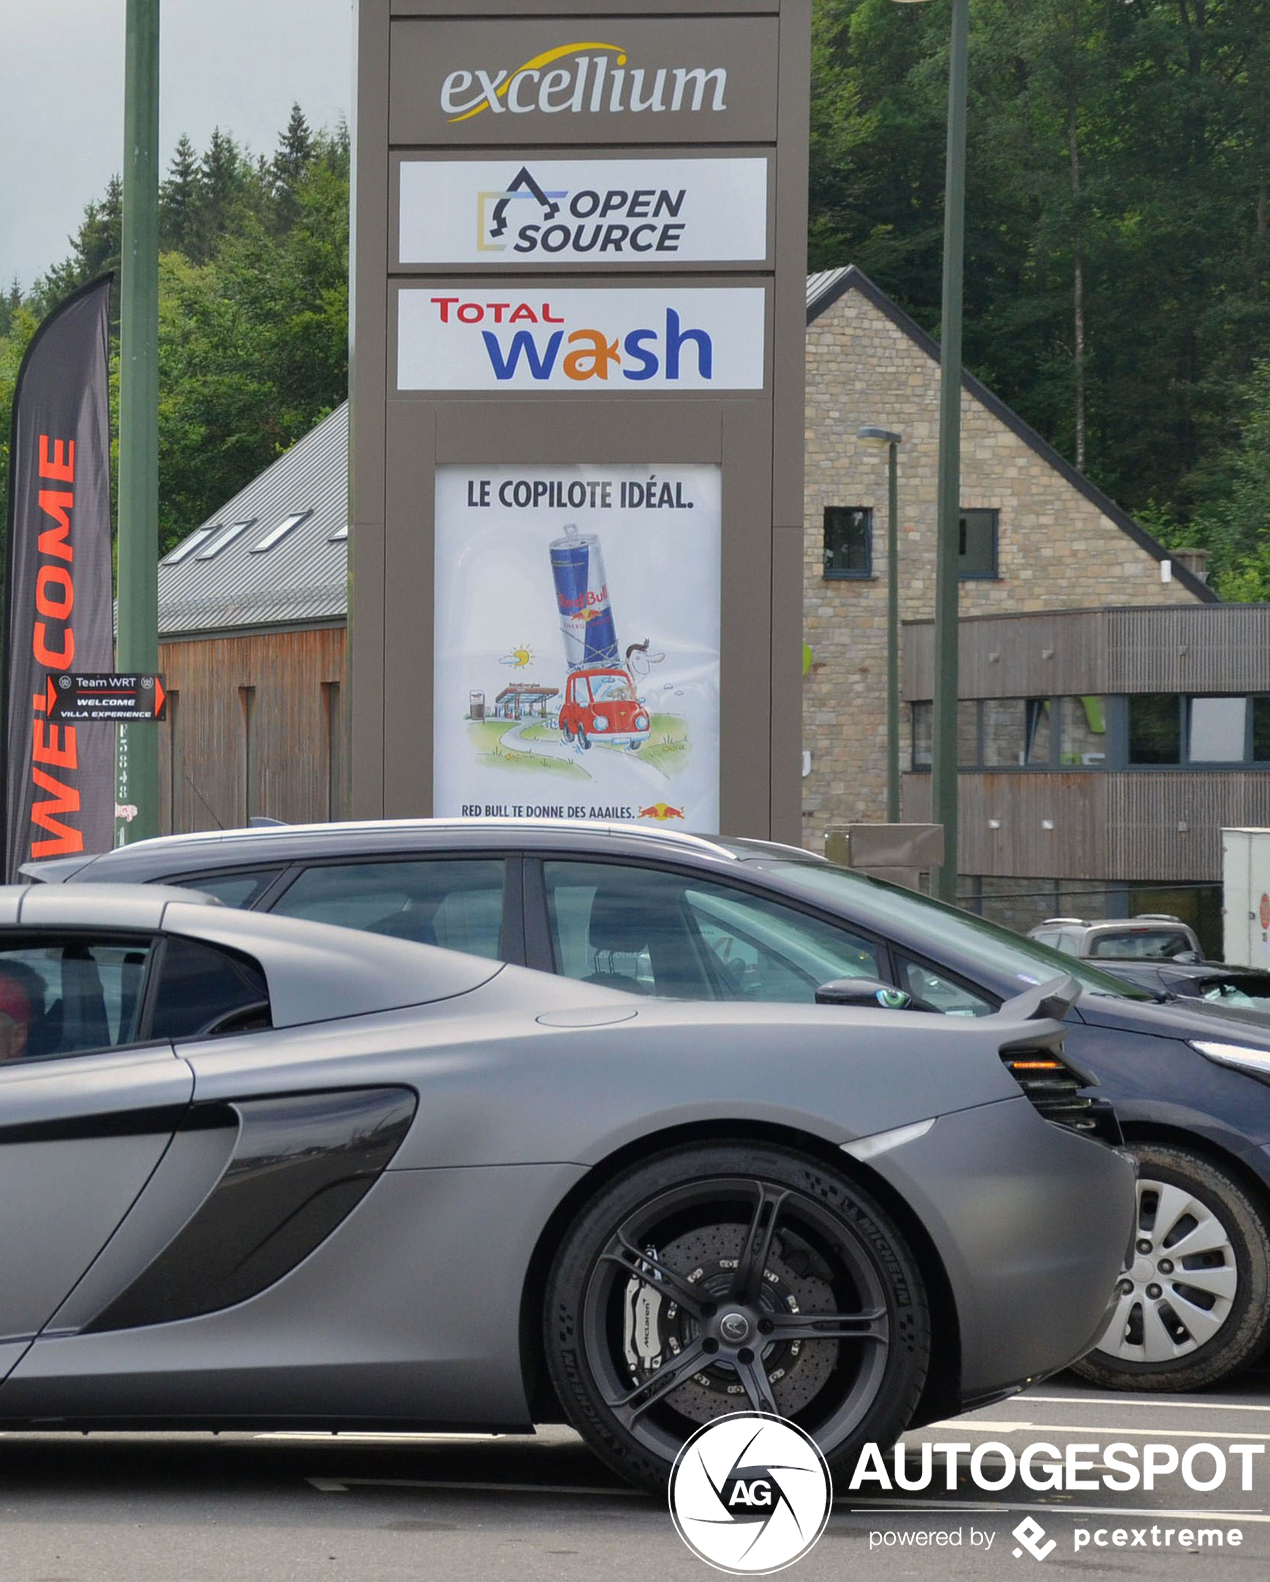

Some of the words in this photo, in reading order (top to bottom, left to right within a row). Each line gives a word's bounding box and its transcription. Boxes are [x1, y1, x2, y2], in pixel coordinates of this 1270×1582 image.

[440, 55, 727, 114] excellium
[569, 189, 686, 219] OPEN
[513, 223, 686, 253] SOURCE
[430, 297, 565, 324] TOTAL
[481, 307, 712, 381] wash
[467, 480, 491, 507] LE
[498, 480, 612, 508] COPILOTE
[620, 475, 694, 509] IDÉAL.
[30, 434, 84, 858] WECOME
[76, 677, 107, 687] Team
[109, 677, 137, 687] WRT
[76, 699, 136, 707] WELCOME
[461, 805, 482, 818] RED
[485, 805, 509, 818] BULL
[512, 805, 524, 818] TE
[526, 805, 564, 819] DONNE
[567, 806, 586, 819] DES
[588, 806, 635, 820] AAAILES.
